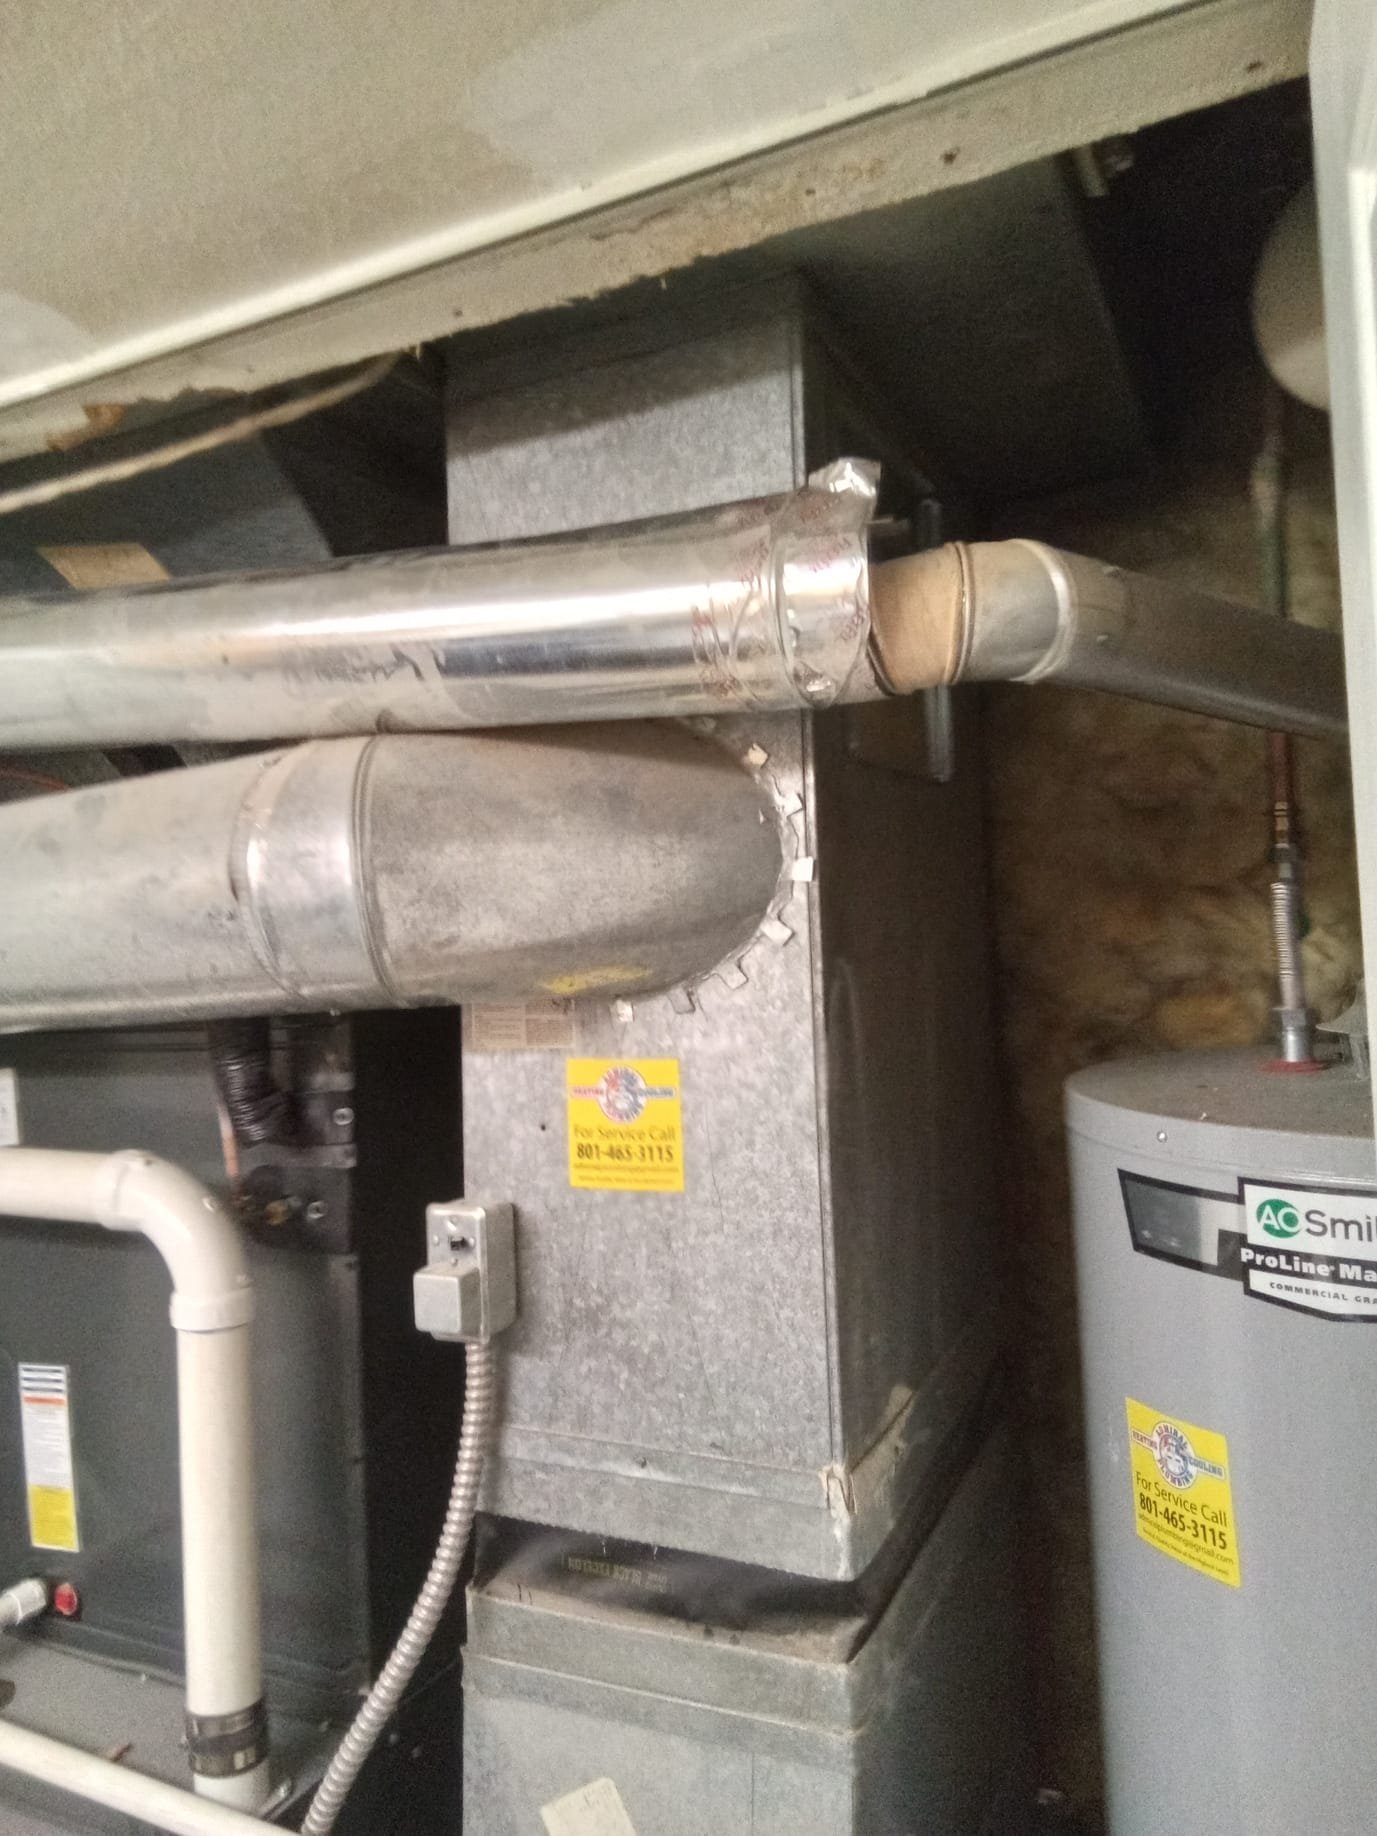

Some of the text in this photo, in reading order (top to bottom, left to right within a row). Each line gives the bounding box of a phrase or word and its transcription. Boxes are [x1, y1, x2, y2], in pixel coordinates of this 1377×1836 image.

[597, 1126, 646, 1140] Service
[649, 1126, 676, 1141] Call
[577, 1143, 674, 1162] 801-465-3115
[1305, 1210, 1377, 1242] Smi
[1269, 1282, 1348, 1301] COMMERCIAL
[1136, 1471, 1228, 1527] For Service Call
[1139, 1492, 1228, 1550] 801-465-3115
